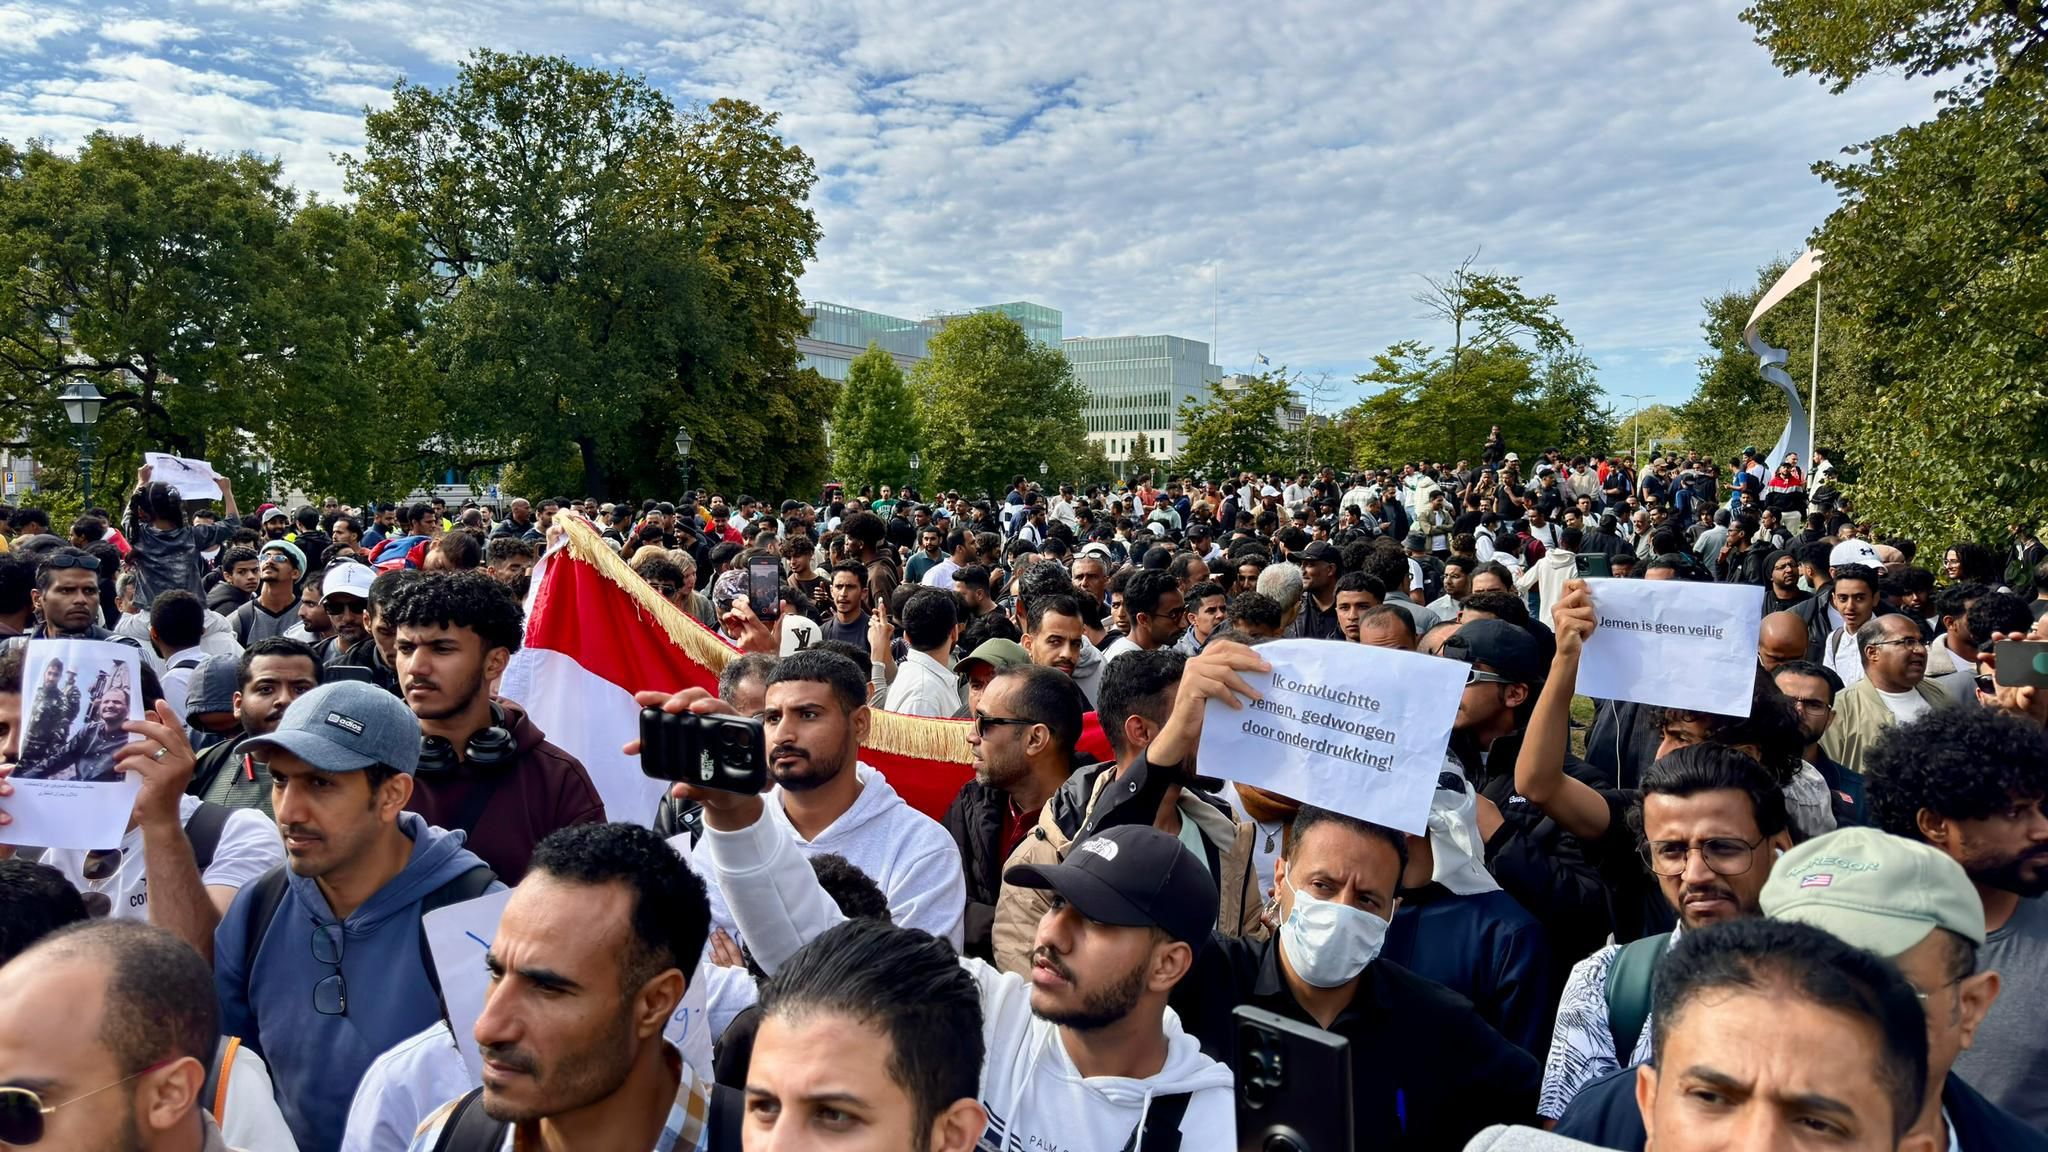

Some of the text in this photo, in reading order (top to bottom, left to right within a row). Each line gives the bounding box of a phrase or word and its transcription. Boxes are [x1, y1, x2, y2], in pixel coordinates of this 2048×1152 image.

[1599, 616, 1723, 639] Jemen is geen veilig
[1272, 673, 1381, 712] Ik ontvluchtte
[1250, 699, 1396, 743] Jemen, gedwongen
[1241, 720, 1394, 772] door onderdrukking!
[130, 892, 148, 907] CO
[1029, 1135, 1057, 1152] PALM
